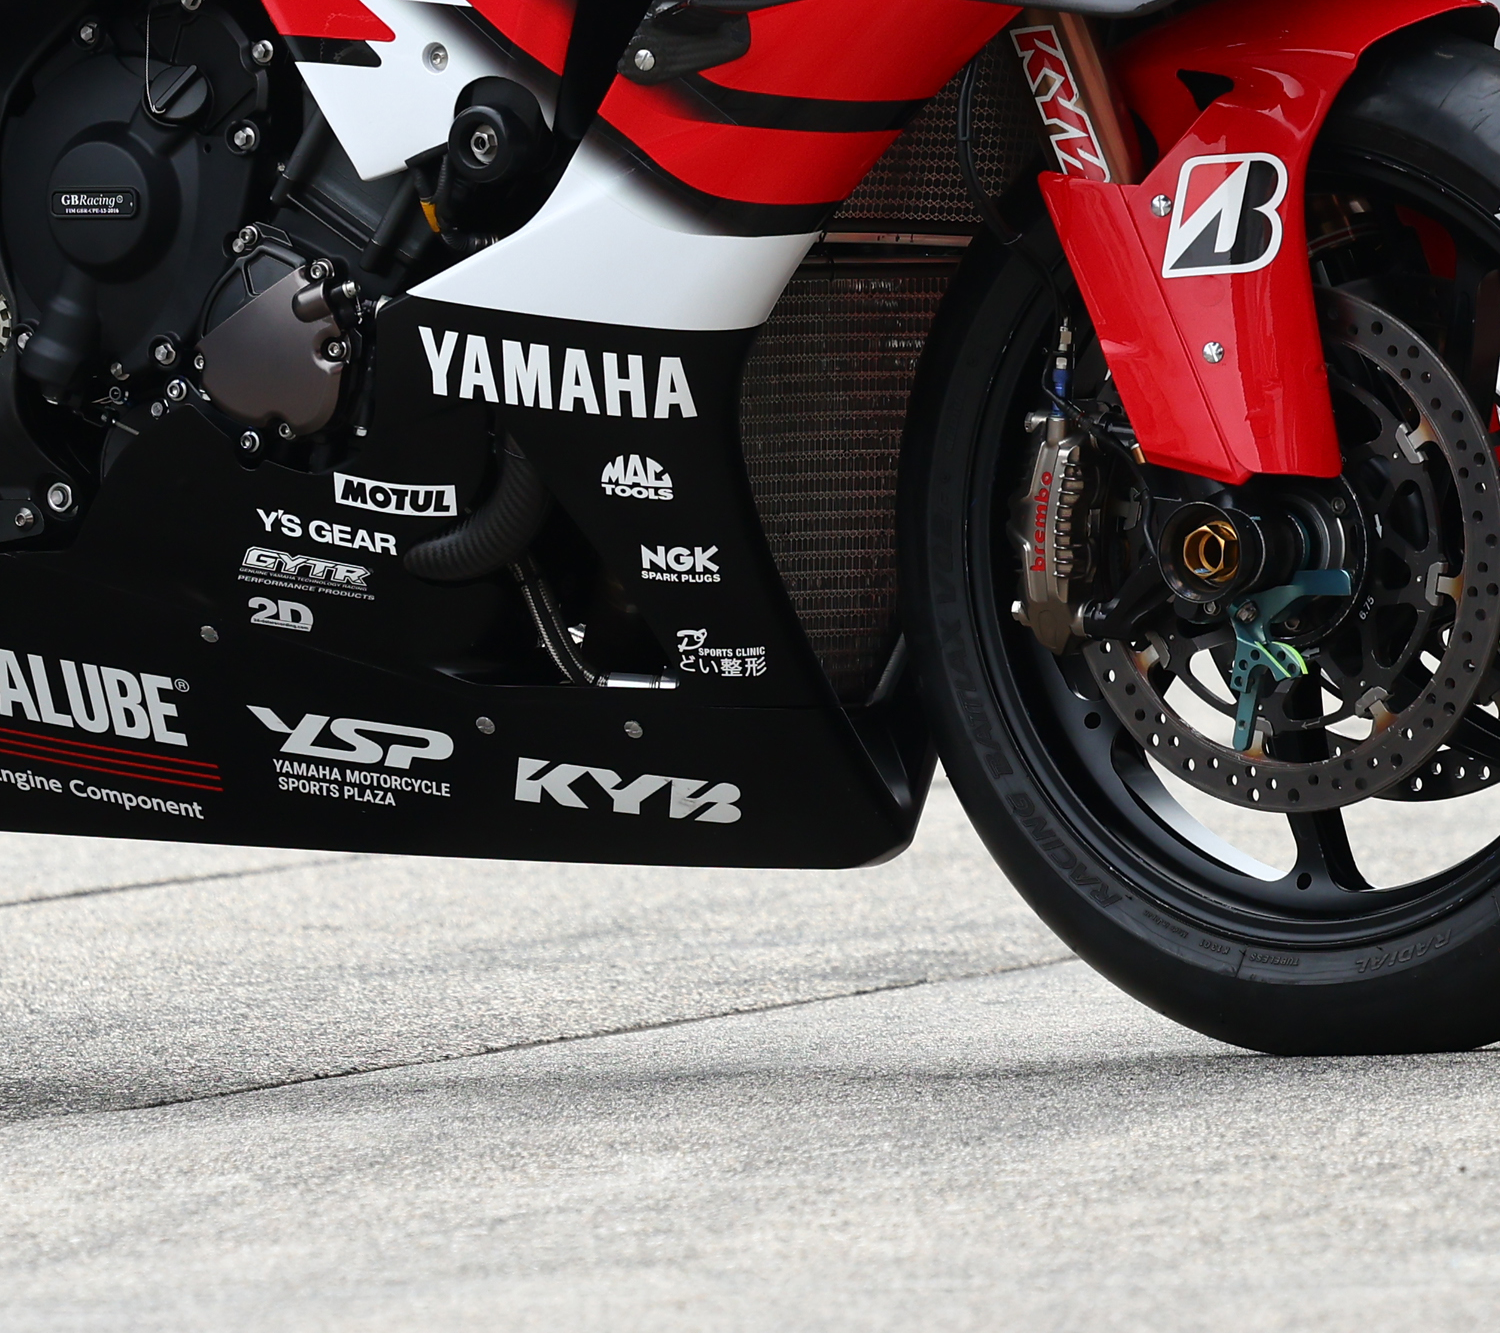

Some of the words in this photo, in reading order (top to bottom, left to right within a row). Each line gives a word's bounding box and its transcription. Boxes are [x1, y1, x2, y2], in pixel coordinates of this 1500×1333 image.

[418, 325, 699, 420] YAMAHA
[601, 454, 674, 487] MAC
[340, 478, 451, 513] MOTUL
[601, 484, 674, 501] TOOLS
[256, 508, 303, 538] Y'S
[308, 520, 398, 557] GEAR
[1030, 470, 1054, 574] brembo
[241, 546, 371, 587] GYTR
[641, 544, 720, 574] NGK
[237, 574, 316, 592] PERFORMANCE
[317, 587, 376, 601] PRODUCTS
[239, 566, 269, 576] GENUINE
[269, 571, 296, 580] YAMAHA
[297, 576, 342, 588] TECHNOLOGY
[342, 583, 368, 592] RACING
[641, 571, 680, 582] SPARK
[682, 572, 721, 583] PLUGS
[248, 596, 314, 626] 2D
[1358, 595, 1376, 621] 6.75
[679, 654, 768, 678] どい整形
[698, 647, 734, 658] SPORTS
[735, 646, 766, 657] CLINIC
[246, 704, 455, 770] YSP
[272, 758, 343, 783] YAMAHA
[345, 768, 452, 798] MOTORCYCLE
[277, 776, 341, 799] SPORTS
[343, 785, 397, 807] PLAZA
[513, 756, 743, 825] KYB
[69, 779, 206, 821] Component
